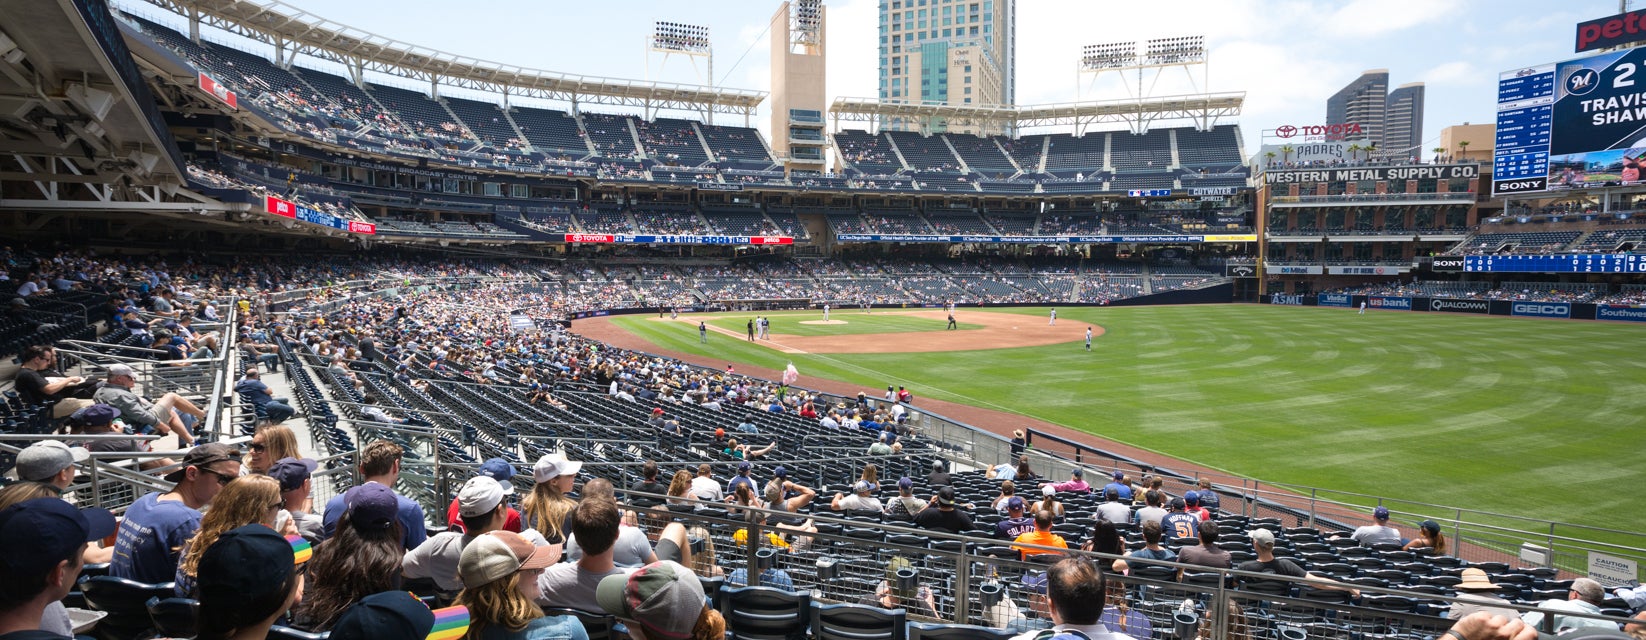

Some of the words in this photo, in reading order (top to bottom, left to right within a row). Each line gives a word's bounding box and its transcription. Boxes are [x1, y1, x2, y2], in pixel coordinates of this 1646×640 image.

[1613, 59, 1646, 88] 2
[1302, 122, 1362, 135] TOYOTA
[1297, 144, 1343, 159] PADRES
[333, 157, 358, 167] JERRY
[359, 161, 397, 172] COLEMAN
[399, 167, 446, 178] BROADCAST
[448, 173, 478, 181] CENTER
[1266, 170, 1330, 183] WESTERN
[1336, 171, 1383, 181] METAL
[1388, 167, 1445, 179] SUPPLY
[1451, 166, 1478, 178] CO.
[1499, 180, 1542, 190] SONY
[1193, 187, 1231, 195] CUTWATER
[357, 223, 372, 232] TOYOTA
[1271, 295, 1303, 305] ASML
[1432, 299, 1487, 311] QUALCOMM
[1514, 304, 1568, 315] GEICO
[1168, 514, 1194, 523] HOFFMAN
[1174, 521, 1194, 539] 51
[1596, 558, 1629, 569] CAUTION
